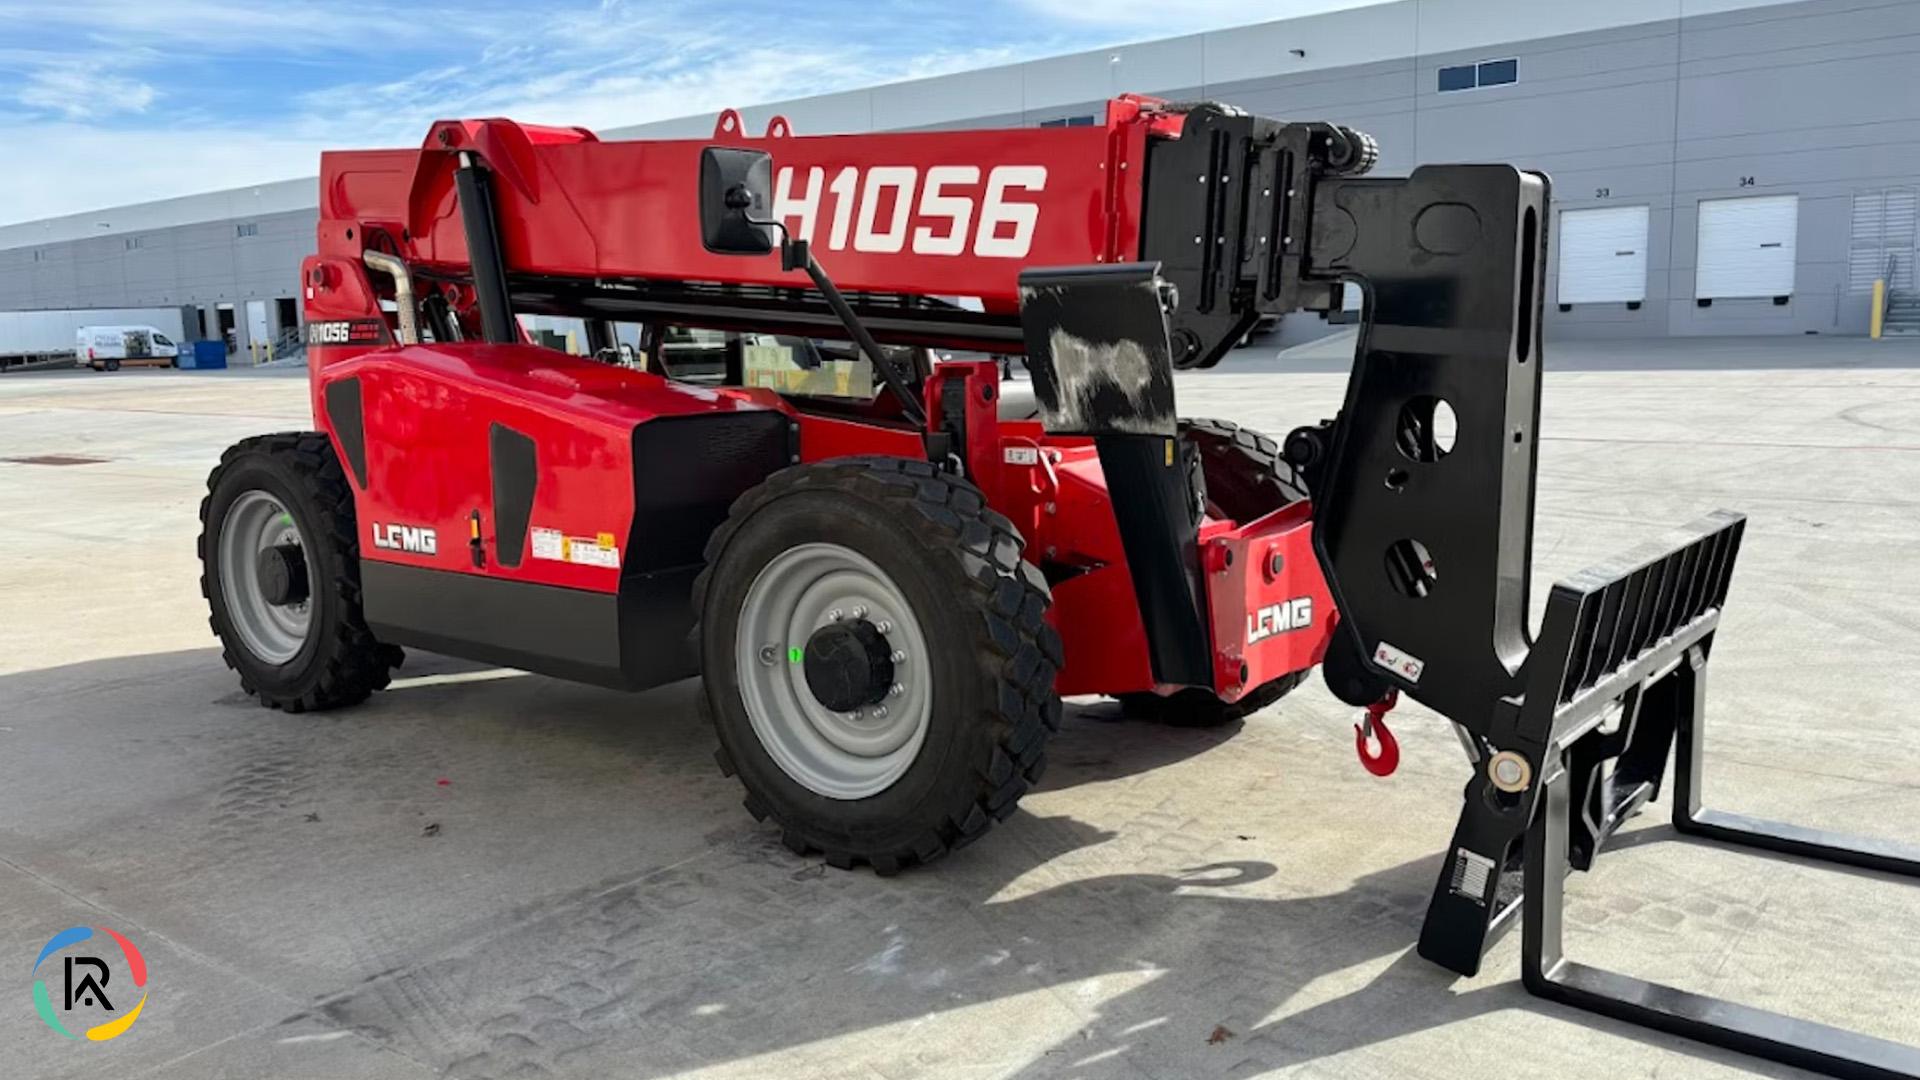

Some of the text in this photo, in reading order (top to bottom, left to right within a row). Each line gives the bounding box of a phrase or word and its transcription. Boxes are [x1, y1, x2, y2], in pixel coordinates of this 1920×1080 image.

[1739, 176, 1755, 187] 34
[1596, 188, 1610, 198] 33
[772, 165, 1047, 258] H1056
